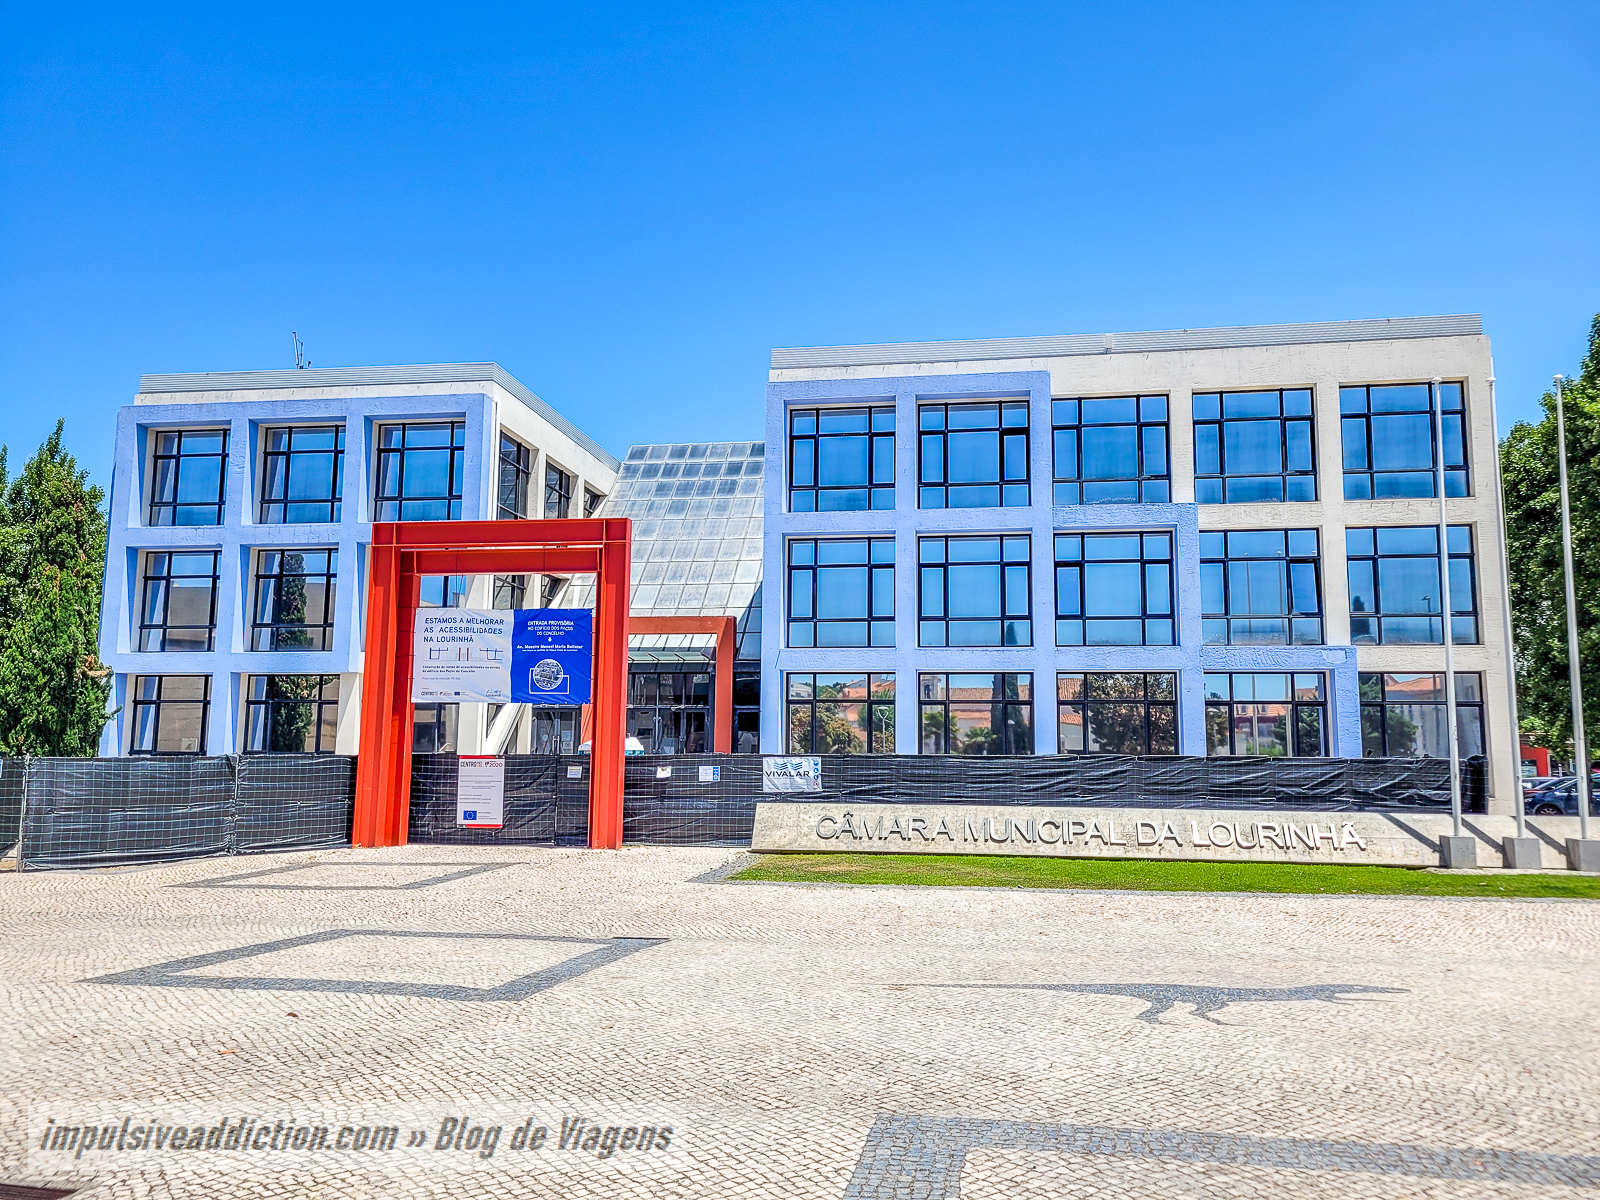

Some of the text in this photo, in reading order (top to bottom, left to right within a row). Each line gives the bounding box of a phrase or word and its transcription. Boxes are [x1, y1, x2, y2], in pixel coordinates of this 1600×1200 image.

[465, 617, 504, 625] MELHORAR
[438, 626, 503, 635] ACESSIBILIDADES
[436, 634, 474, 643] LOURINHÃ
[815, 811, 1367, 851] CÂMARA MUNICIPAL DA LOURINHÃ
